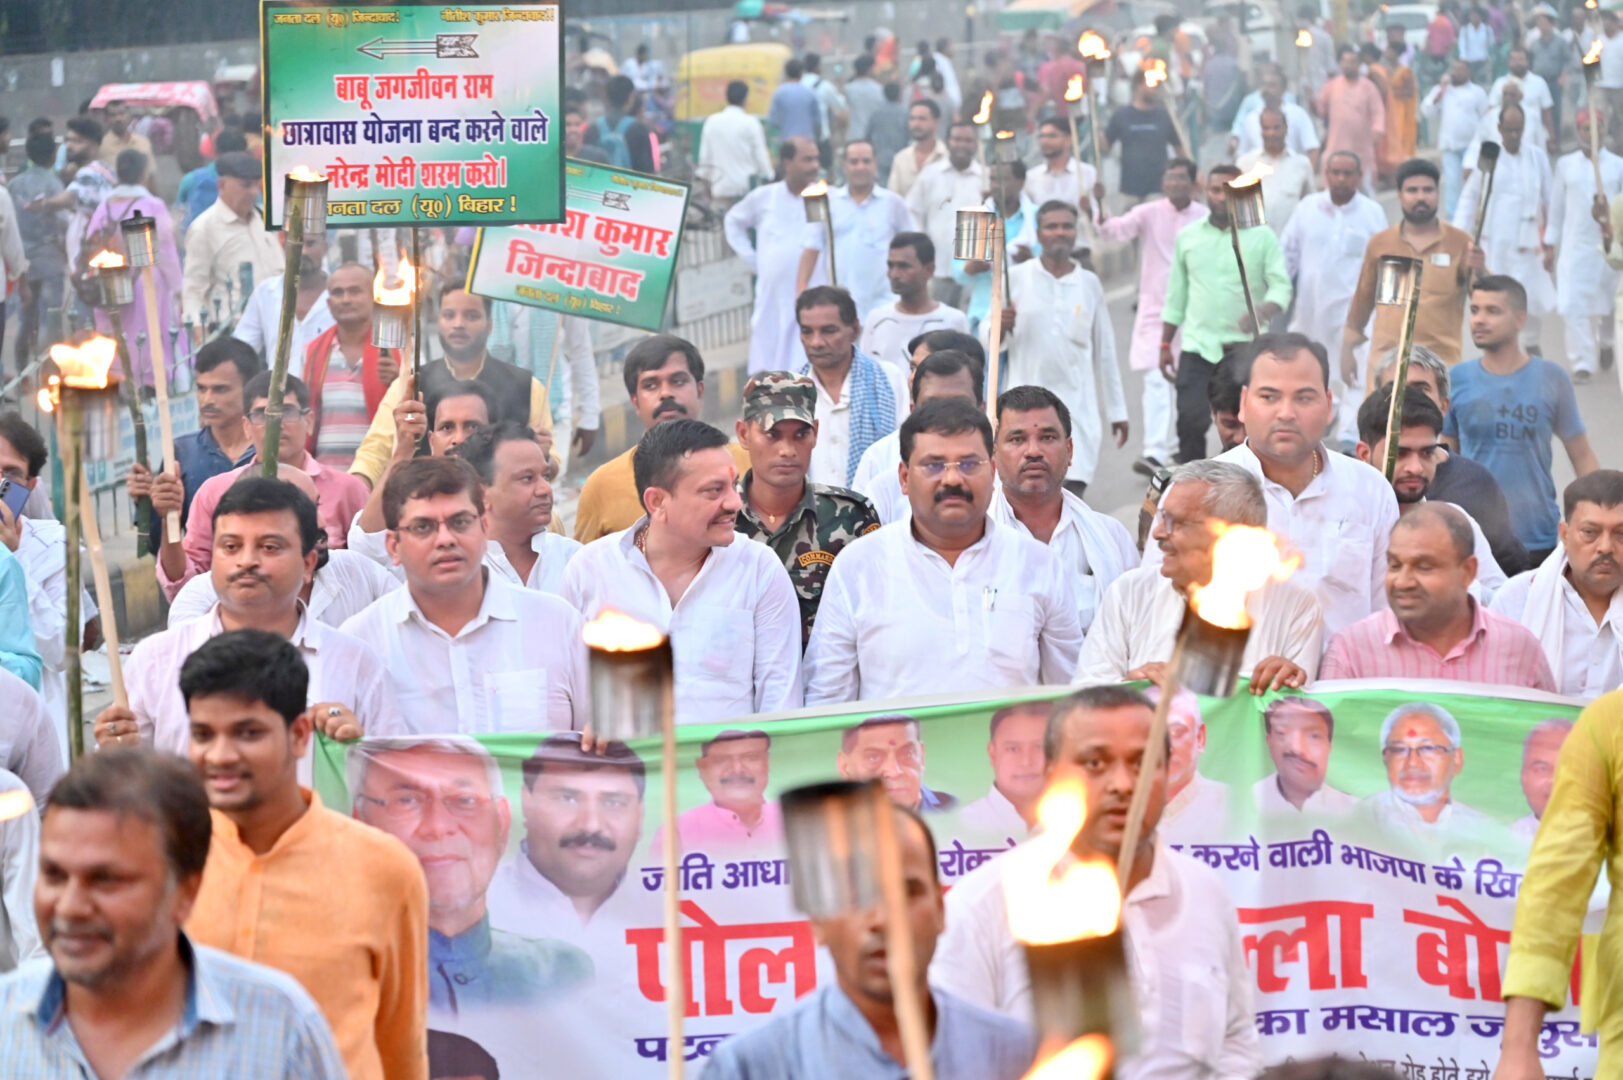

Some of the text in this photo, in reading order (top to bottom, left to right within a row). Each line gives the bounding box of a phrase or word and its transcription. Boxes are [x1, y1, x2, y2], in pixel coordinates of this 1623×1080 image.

[335, 68, 494, 110] बाबू जगजीवन राम
[283, 110, 548, 146] छात्रावास योजना बन्द करने वाले
[325, 157, 369, 189] नरेन्द्र
[375, 156, 415, 188] मोदी
[421, 161, 461, 187] शरम
[327, 200, 366, 217] नता
[371, 199, 401, 215] दल
[458, 195, 504, 214] बिहार
[593, 215, 673, 257] कुमार
[505, 239, 643, 299] जिन्दाबाद
[1495, 421, 1537, 440] BLN
[1496, 403, 1539, 424] +49
[1267, 829, 1333, 868] वाली
[1341, 844, 1427, 885] भाजपा
[1432, 856, 1466, 890] के
[1255, 1008, 1309, 1036] का
[1322, 1005, 1459, 1037] मसाल
